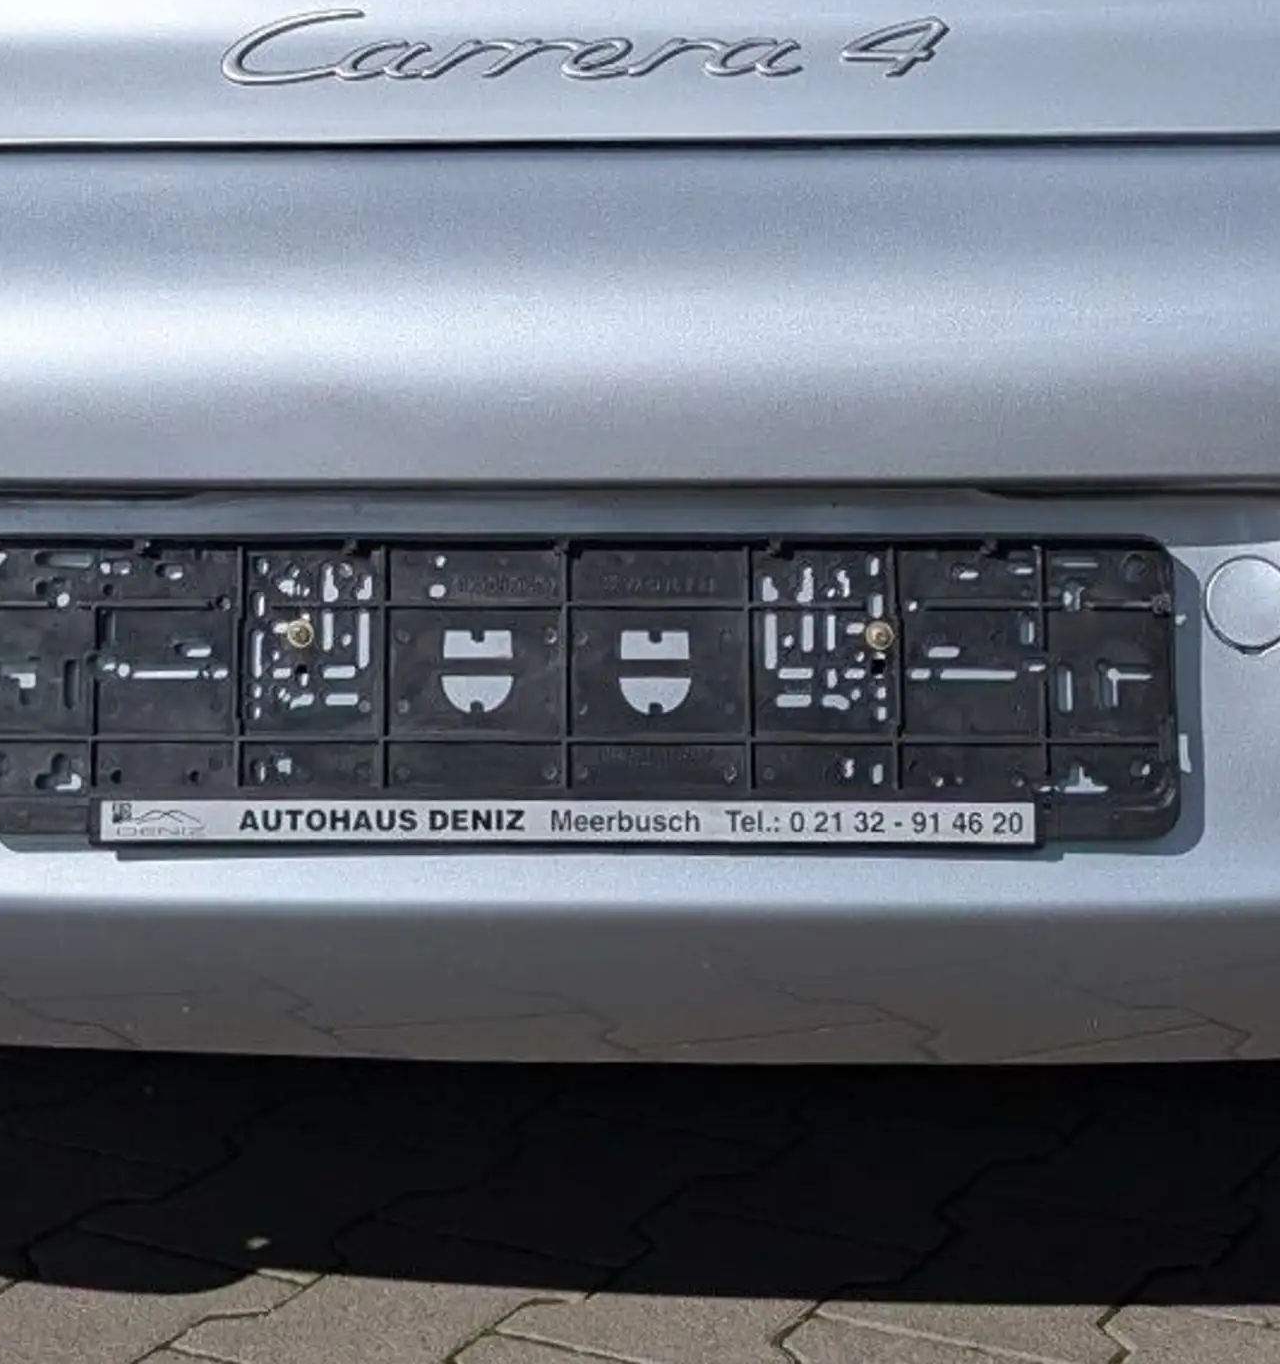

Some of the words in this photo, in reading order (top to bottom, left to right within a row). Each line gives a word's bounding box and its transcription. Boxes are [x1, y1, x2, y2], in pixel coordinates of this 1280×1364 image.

[220, 8, 803, 86] Carrera
[841, 15, 951, 79] 4
[238, 809, 418, 833] AUTOHAUS
[428, 809, 526, 832] DENIZ
[550, 809, 701, 833] Meerbusch
[724, 809, 781, 833] Tel.:
[788, 811, 805, 833] 0
[812, 811, 843, 834] 21
[853, 811, 885, 834] 32
[910, 812, 941, 834] 91
[951, 812, 984, 835] 46
[992, 812, 1023, 835] 20
